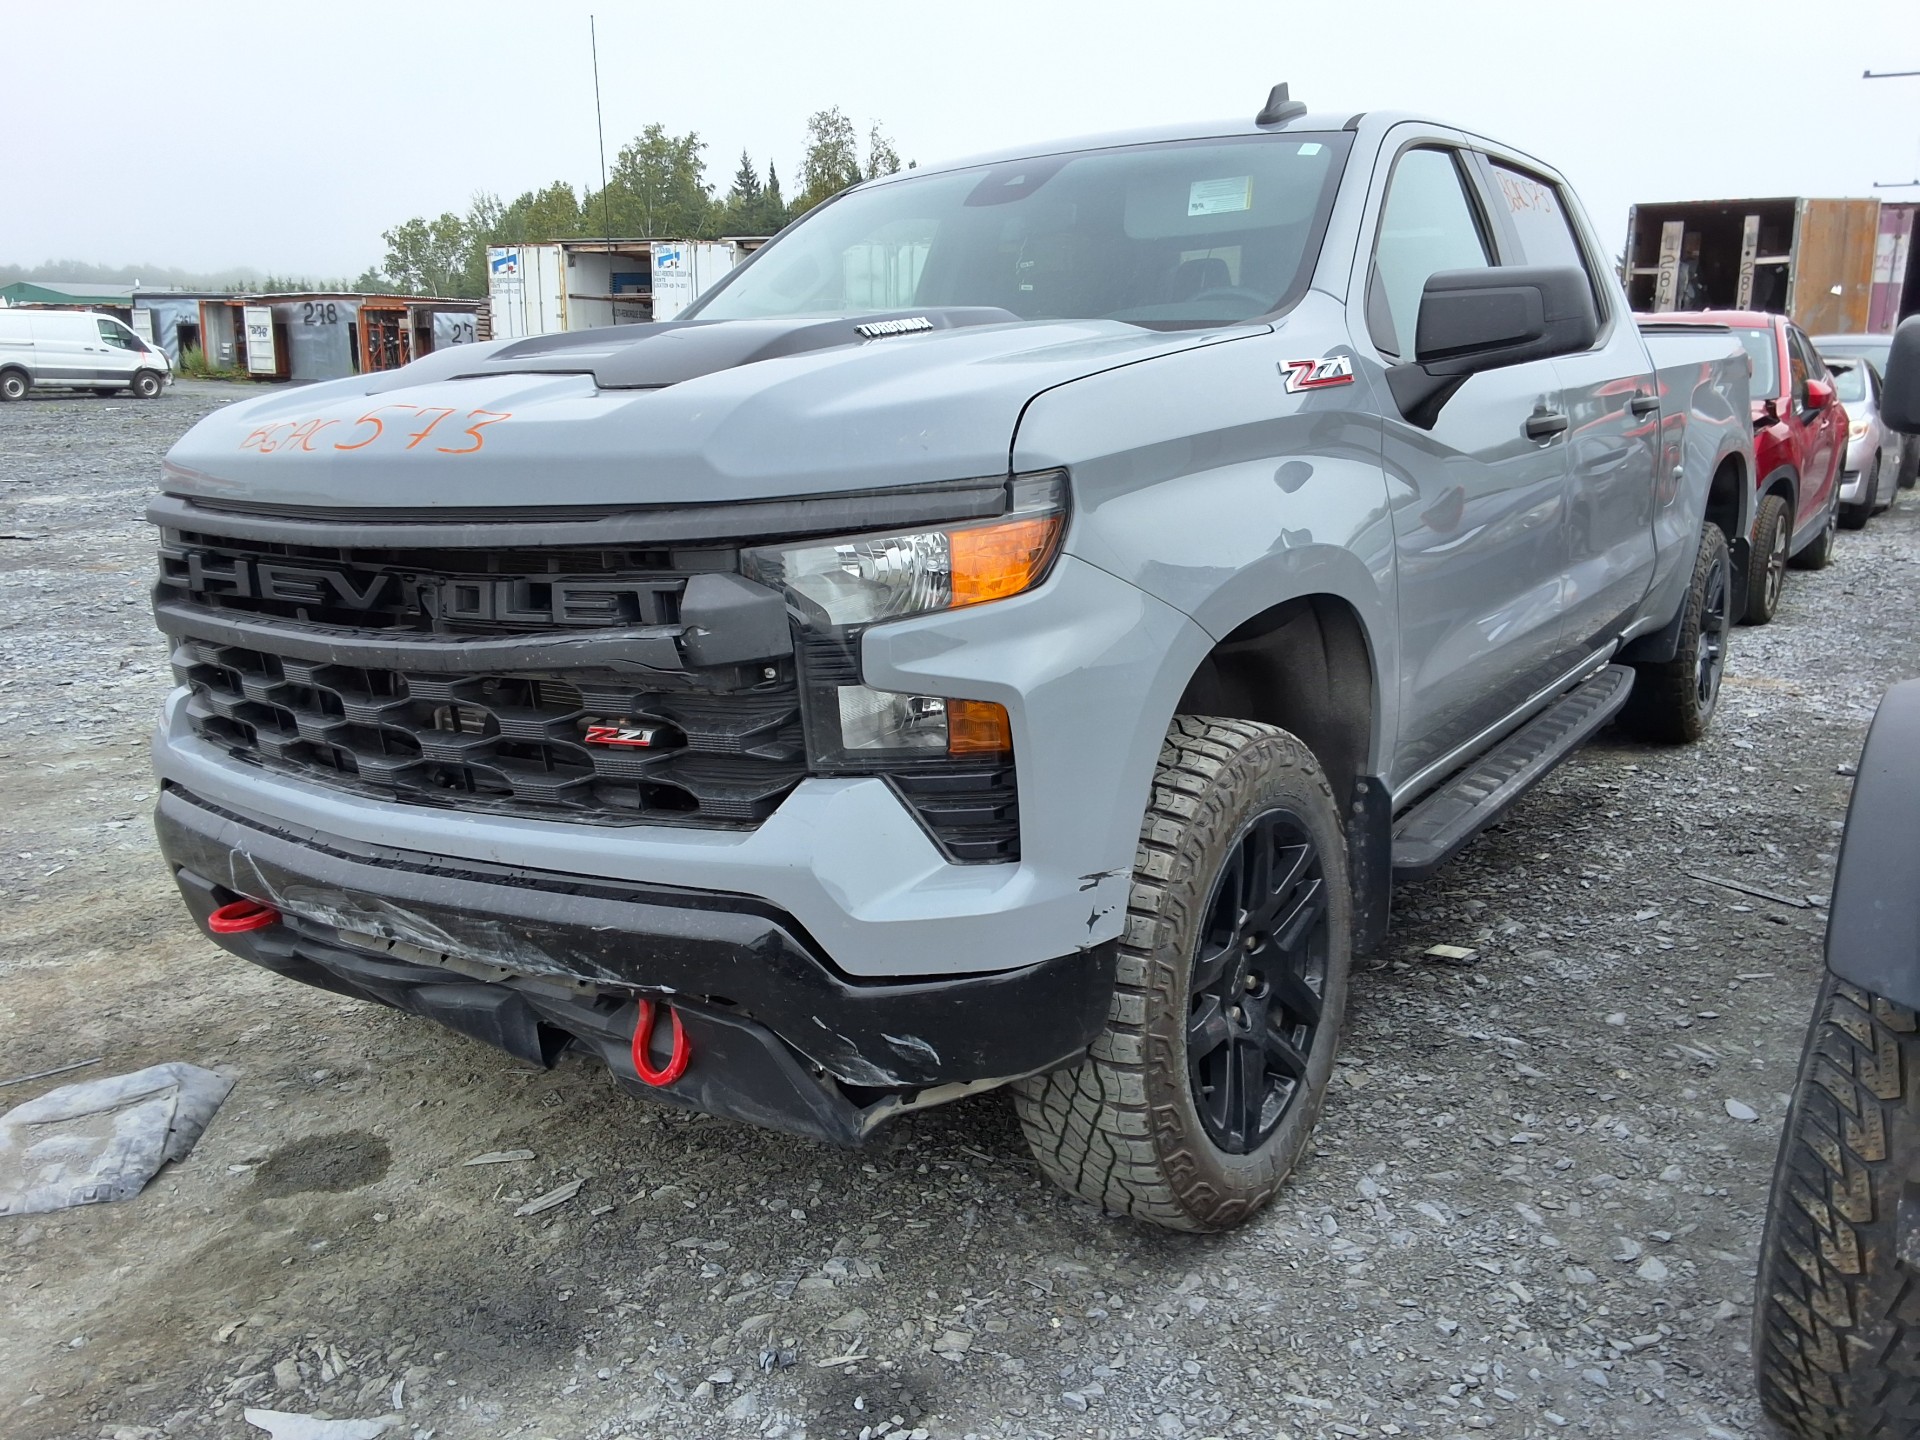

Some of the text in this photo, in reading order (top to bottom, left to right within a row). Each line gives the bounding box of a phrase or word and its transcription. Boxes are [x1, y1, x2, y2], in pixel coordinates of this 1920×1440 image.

[304, 303, 337, 325] 278
[854, 316, 934, 338] TURBOMAX
[1278, 355, 1355, 394] Z71
[157, 547, 685, 625] CHEVOLET
[585, 726, 654, 746] Z71
